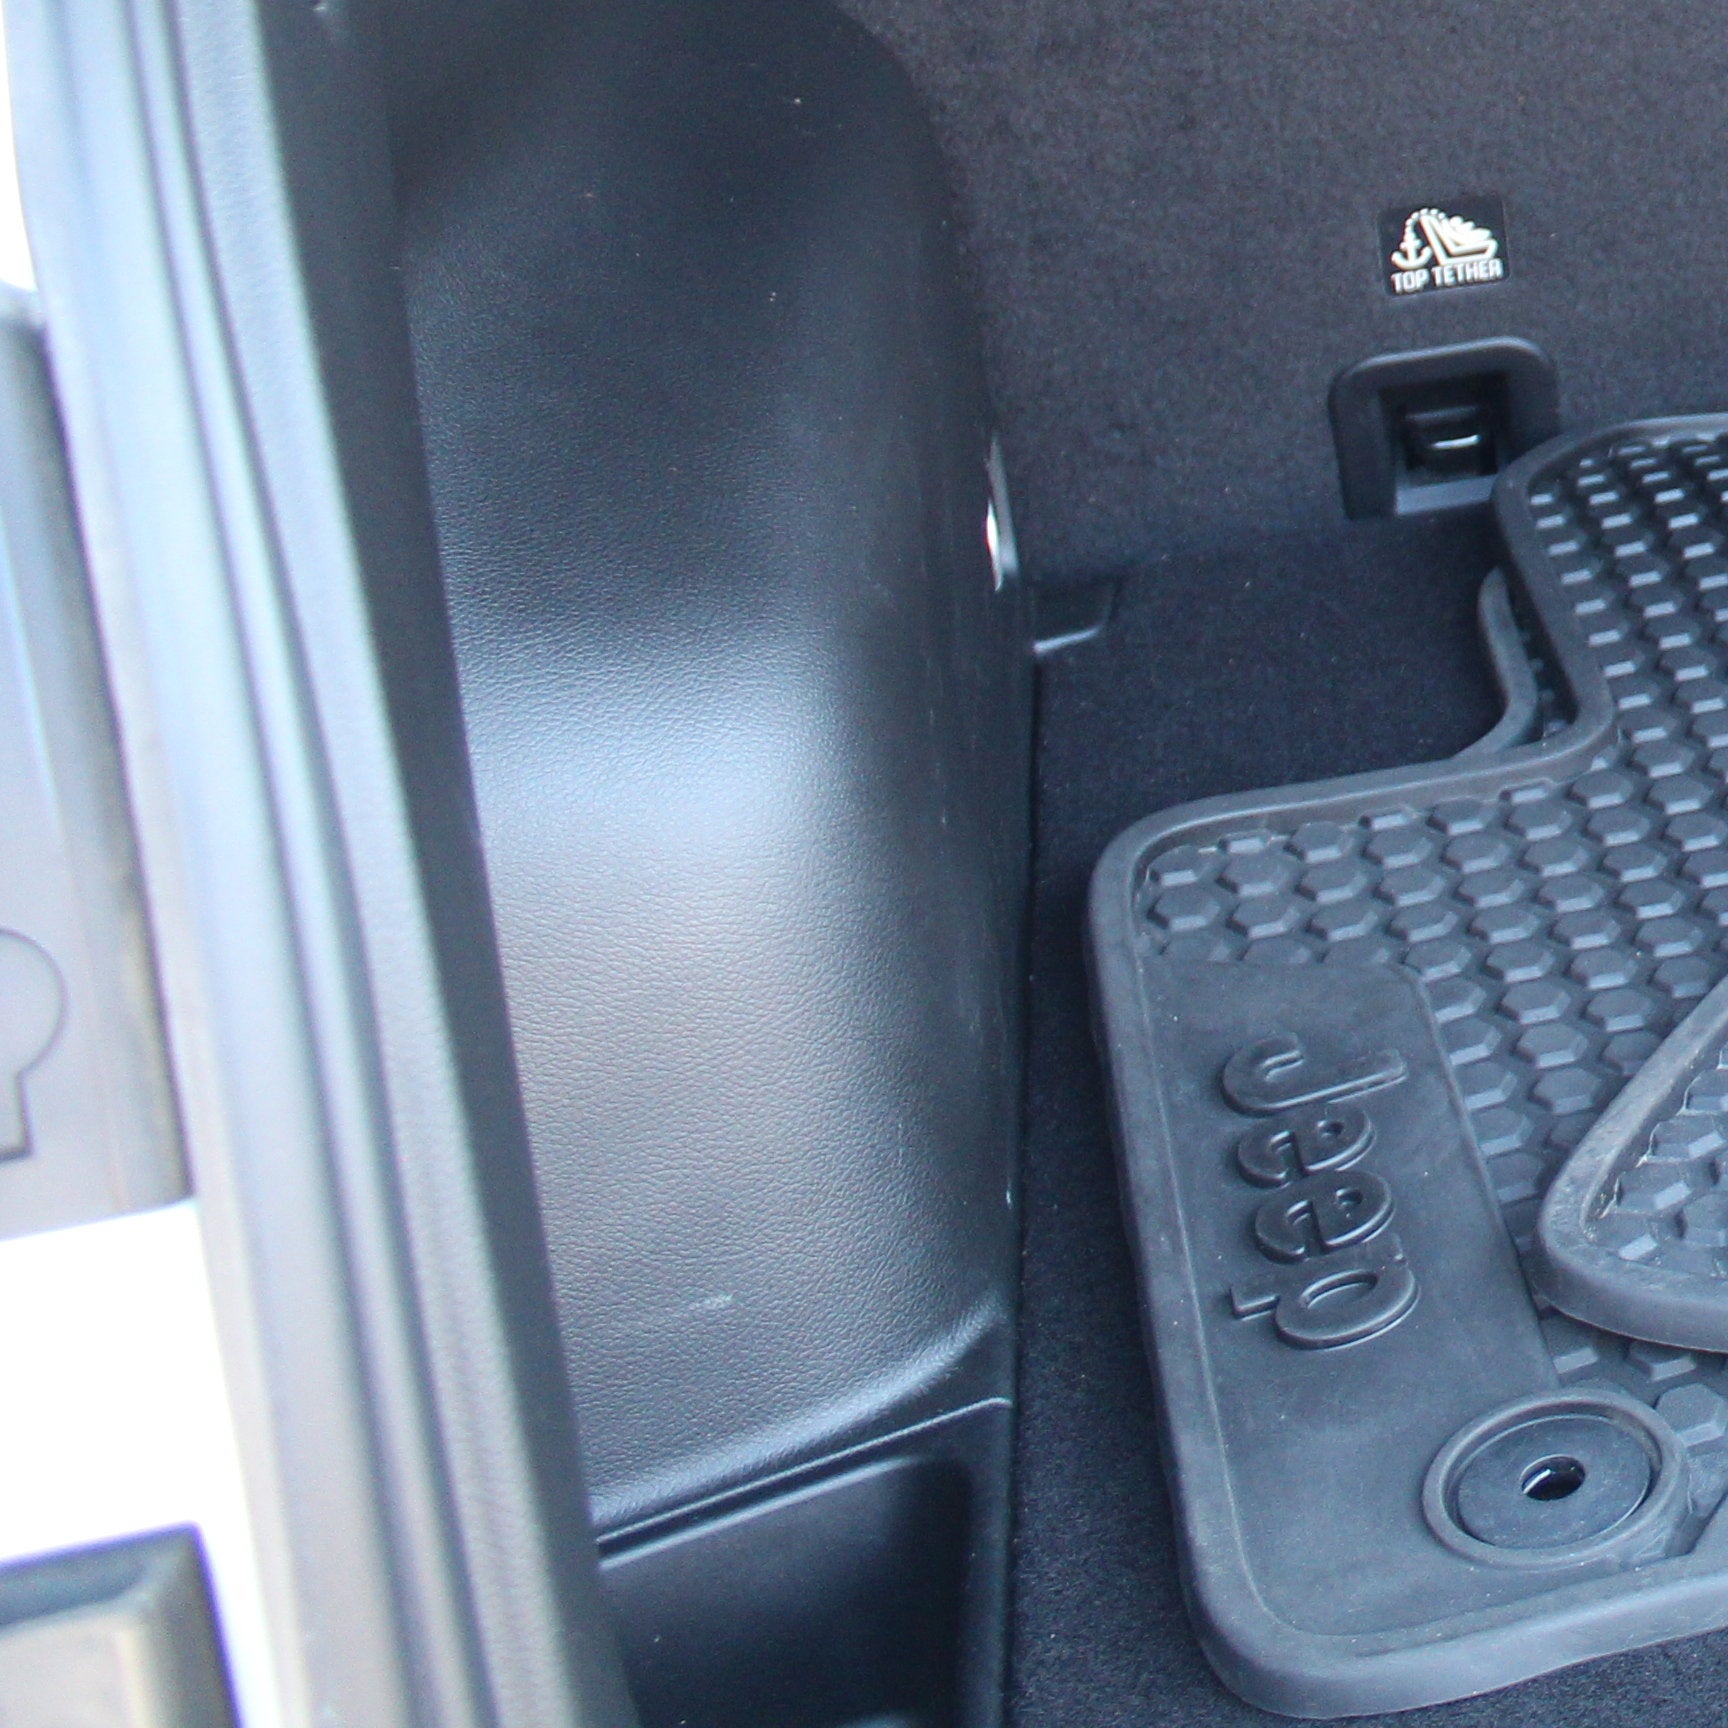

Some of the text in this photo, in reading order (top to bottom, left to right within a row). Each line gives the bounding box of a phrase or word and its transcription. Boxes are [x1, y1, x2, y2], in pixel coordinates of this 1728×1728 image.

[1391, 258, 1503, 294] TOP TETHER
[1222, 1032, 1420, 1350] Jeep
